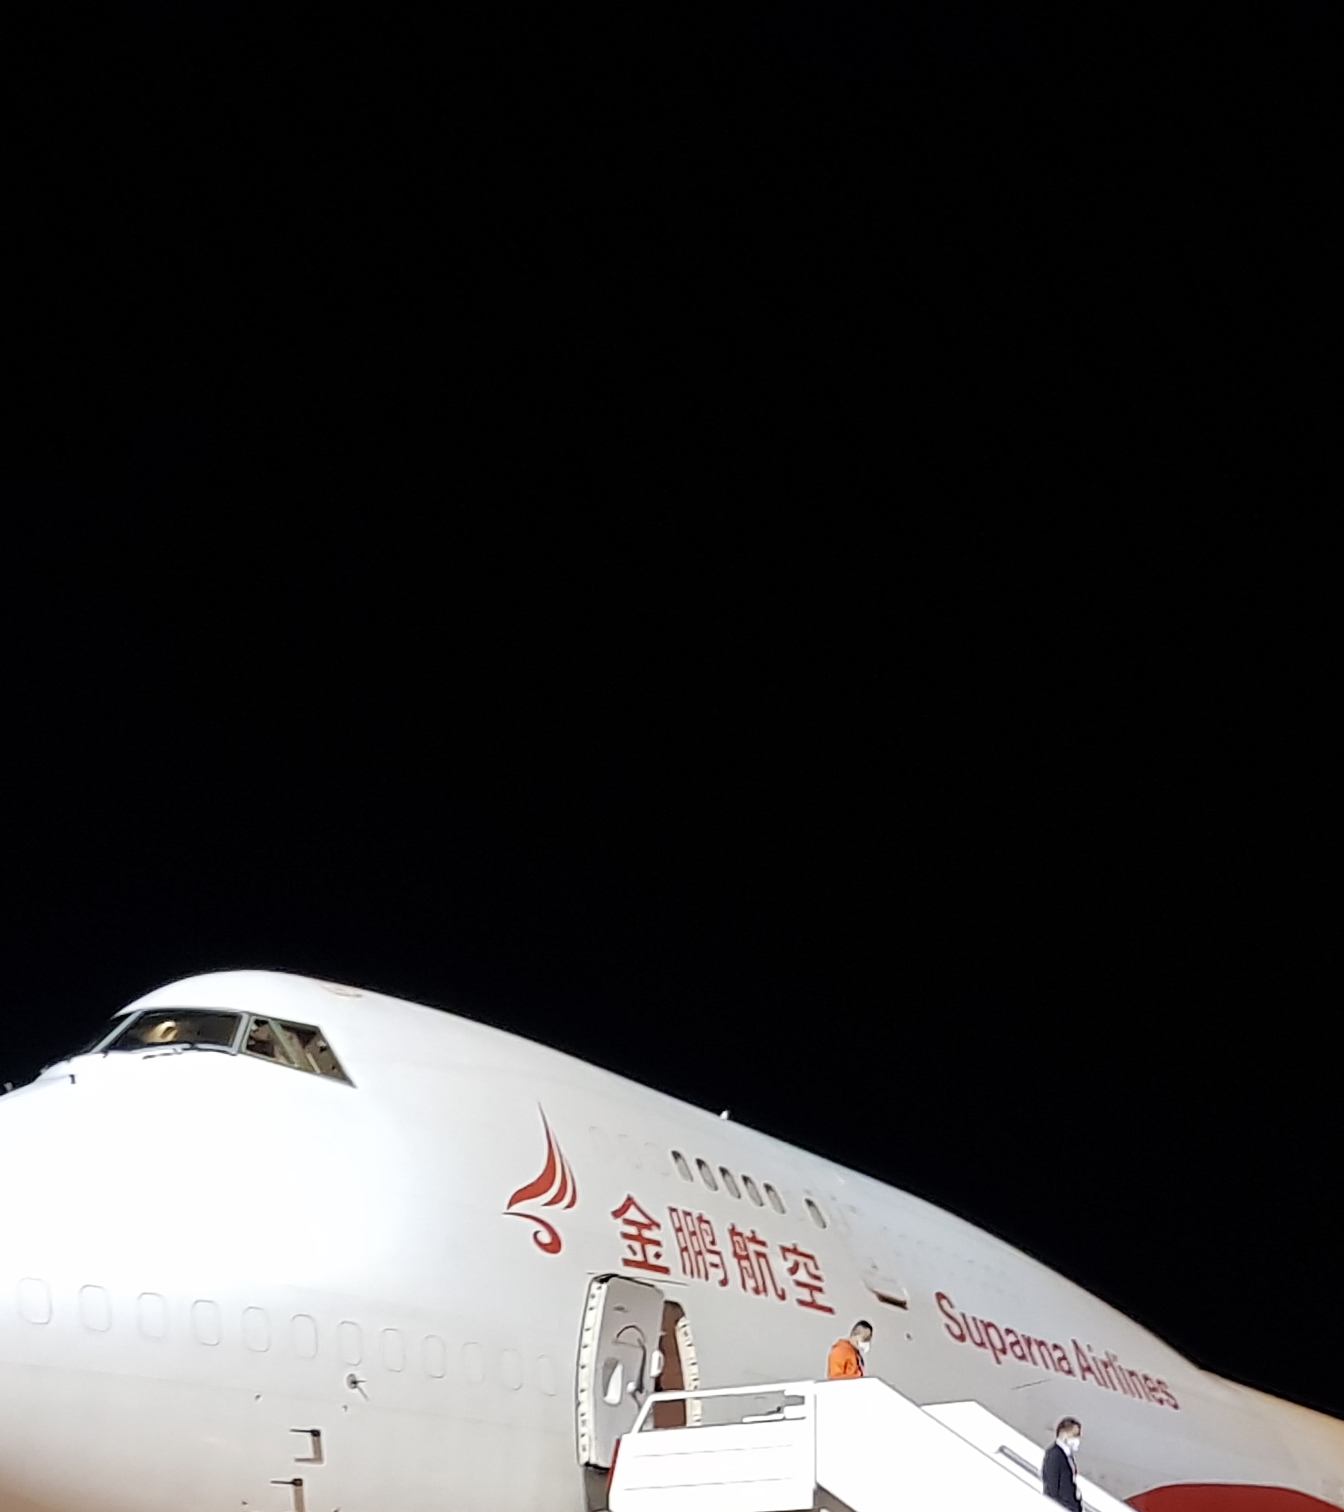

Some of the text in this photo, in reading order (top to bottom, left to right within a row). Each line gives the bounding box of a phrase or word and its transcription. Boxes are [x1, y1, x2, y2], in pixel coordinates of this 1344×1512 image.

[610, 1193, 836, 1315] 金鹏航空
[935, 1291, 1180, 1411] Suparna Airlines
